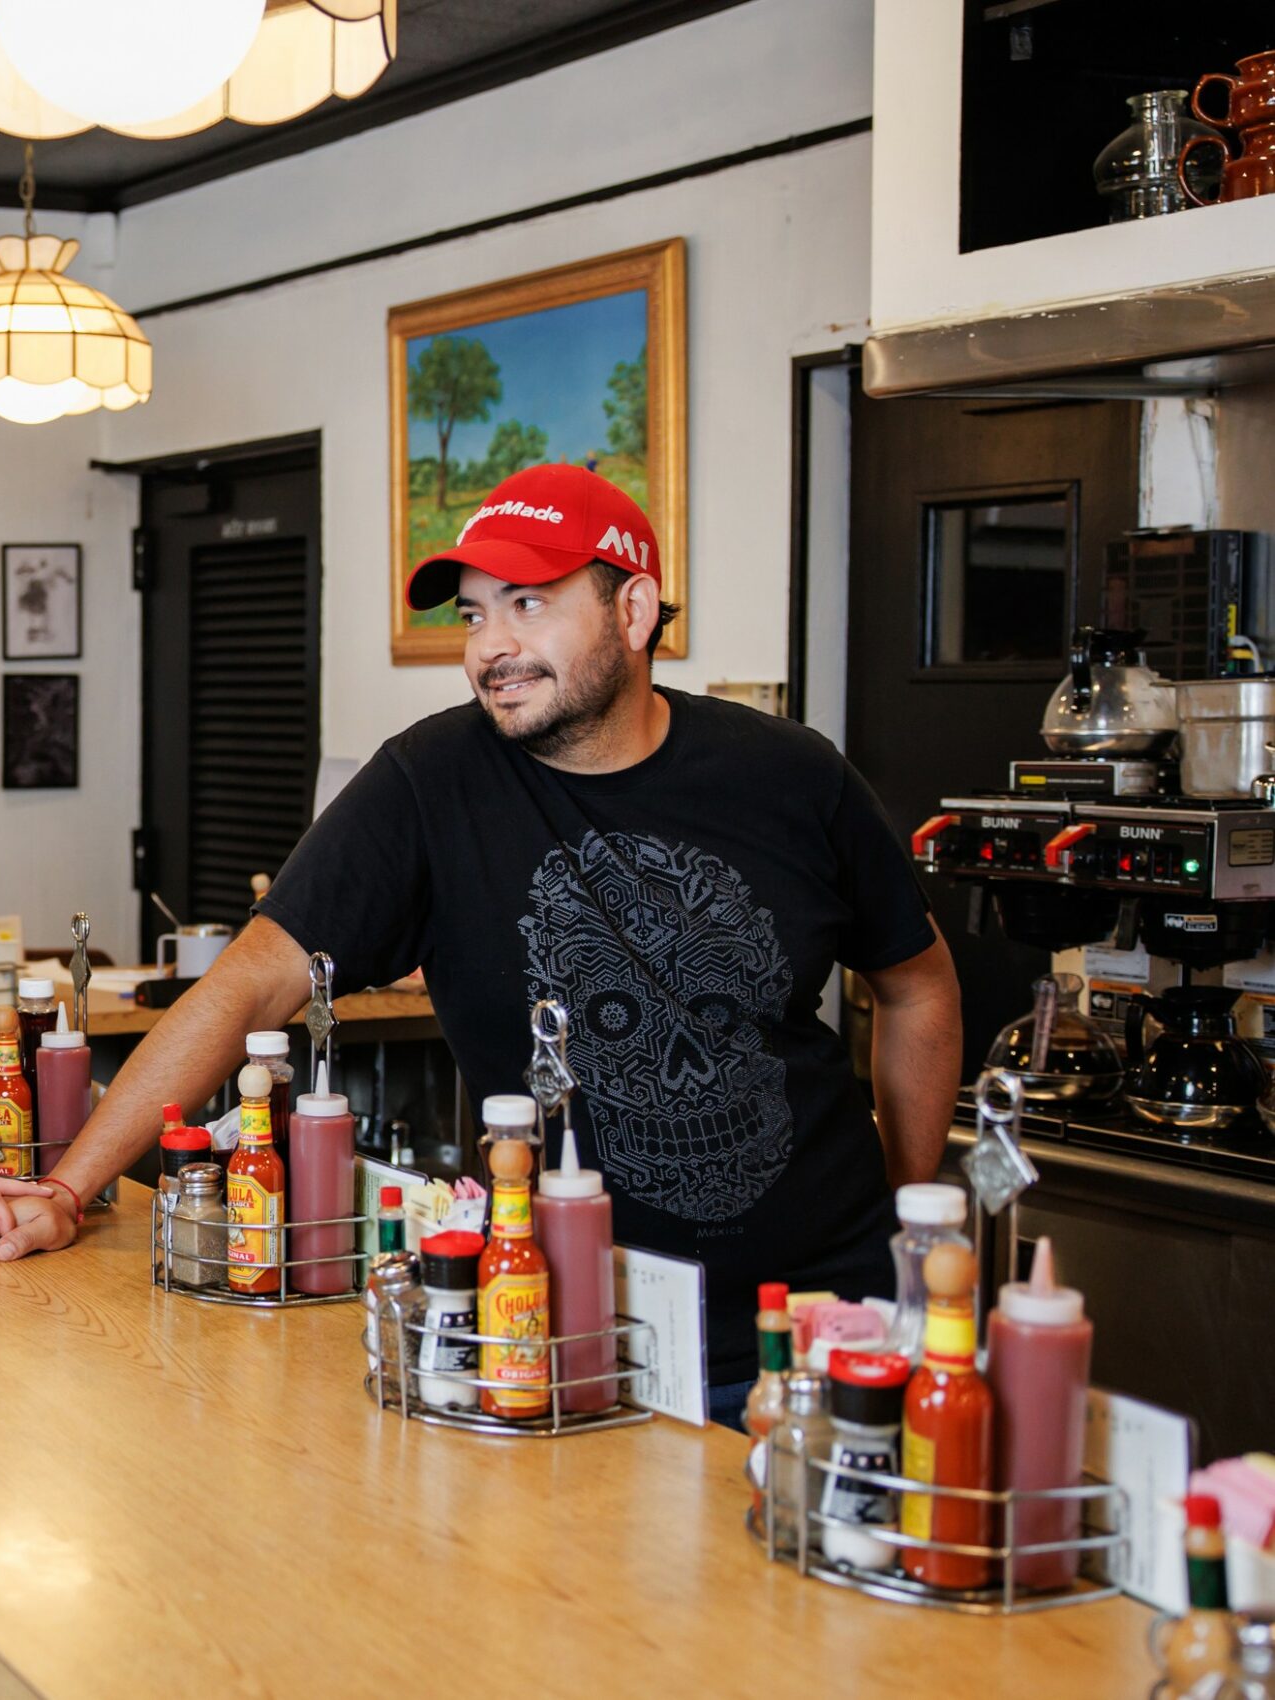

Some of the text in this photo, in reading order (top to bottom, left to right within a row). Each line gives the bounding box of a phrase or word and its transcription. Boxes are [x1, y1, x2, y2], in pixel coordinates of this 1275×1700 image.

[596, 525, 650, 571] M1
[981, 816, 1020, 829] BUNN
[1120, 826, 1162, 840] BUNN
